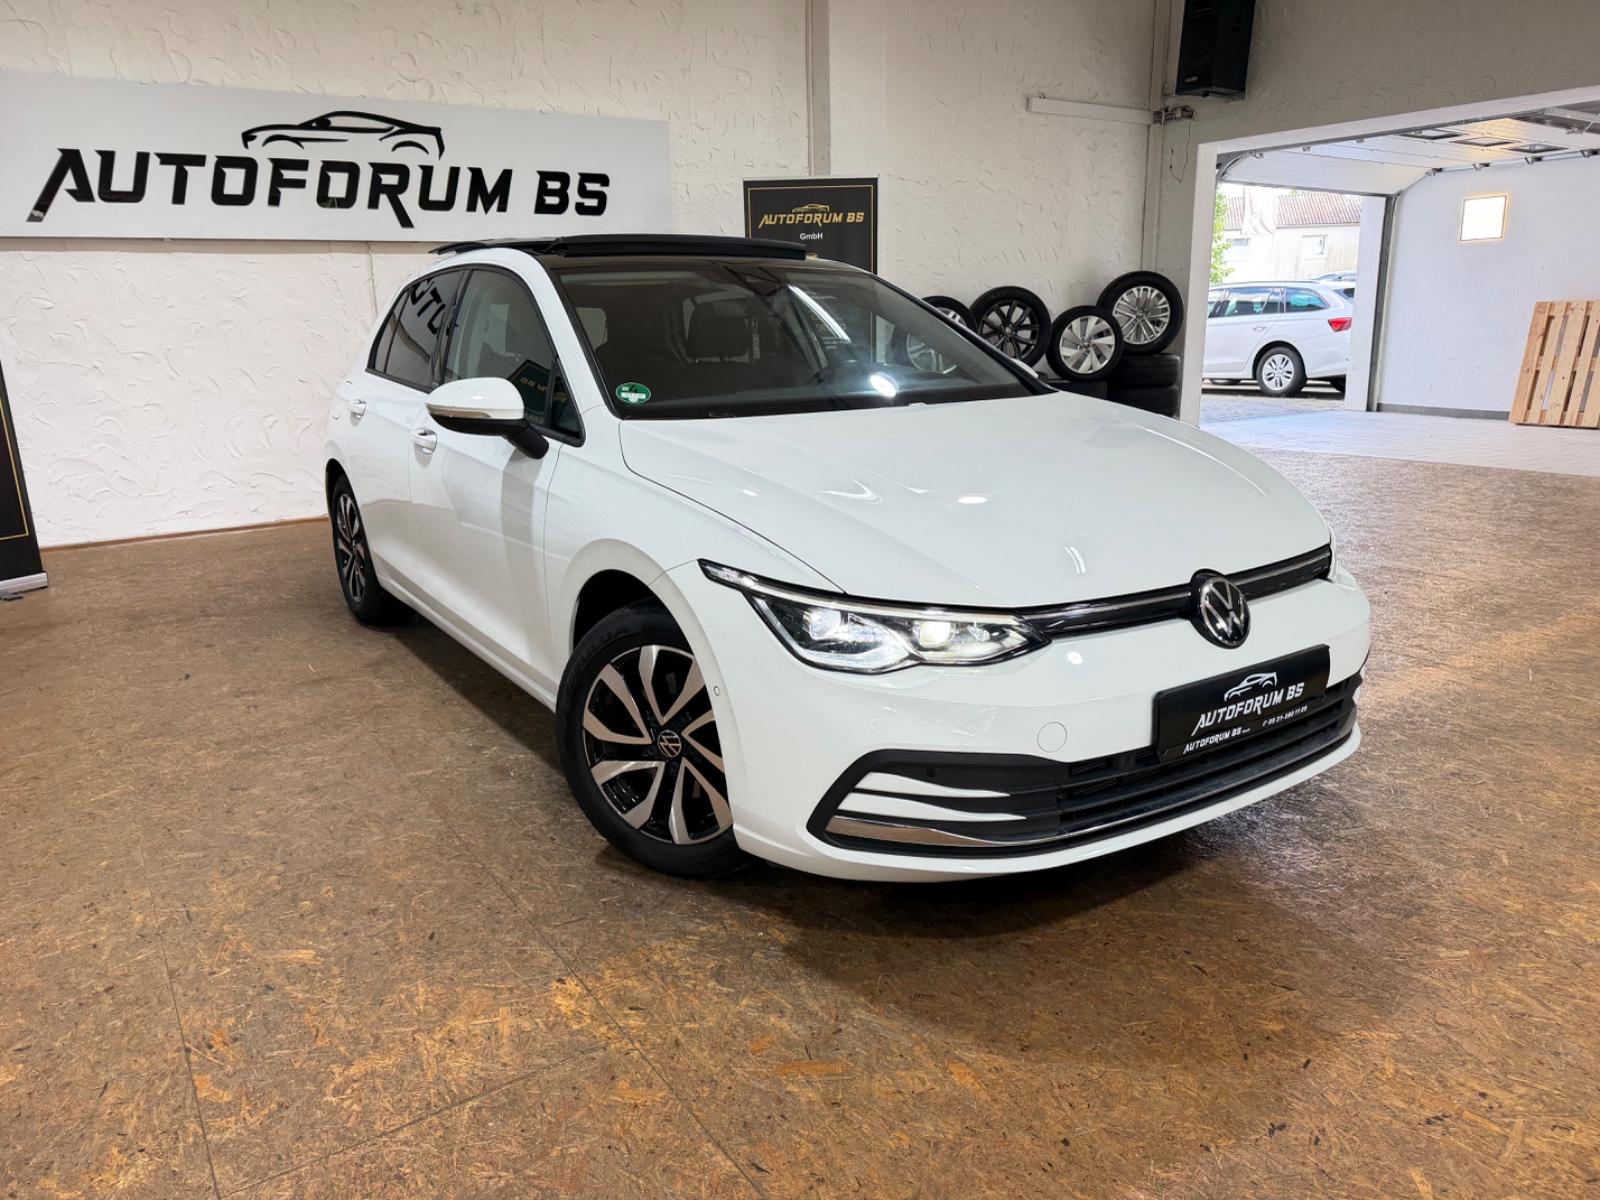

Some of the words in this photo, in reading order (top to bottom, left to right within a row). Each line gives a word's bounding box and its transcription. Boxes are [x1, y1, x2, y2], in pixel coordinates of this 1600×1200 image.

[27, 147, 513, 229] AUTOFORUM
[533, 169, 610, 216] BS
[758, 212, 843, 229] AUTOFORUM
[846, 211, 865, 223] BS
[799, 232, 823, 240] GmbH
[1190, 688, 1284, 736] AUTOFORUM
[1286, 682, 1305, 700] BS
[1183, 731, 1230, 754] AUTOFORUM
[1231, 726, 1242, 737] BS
